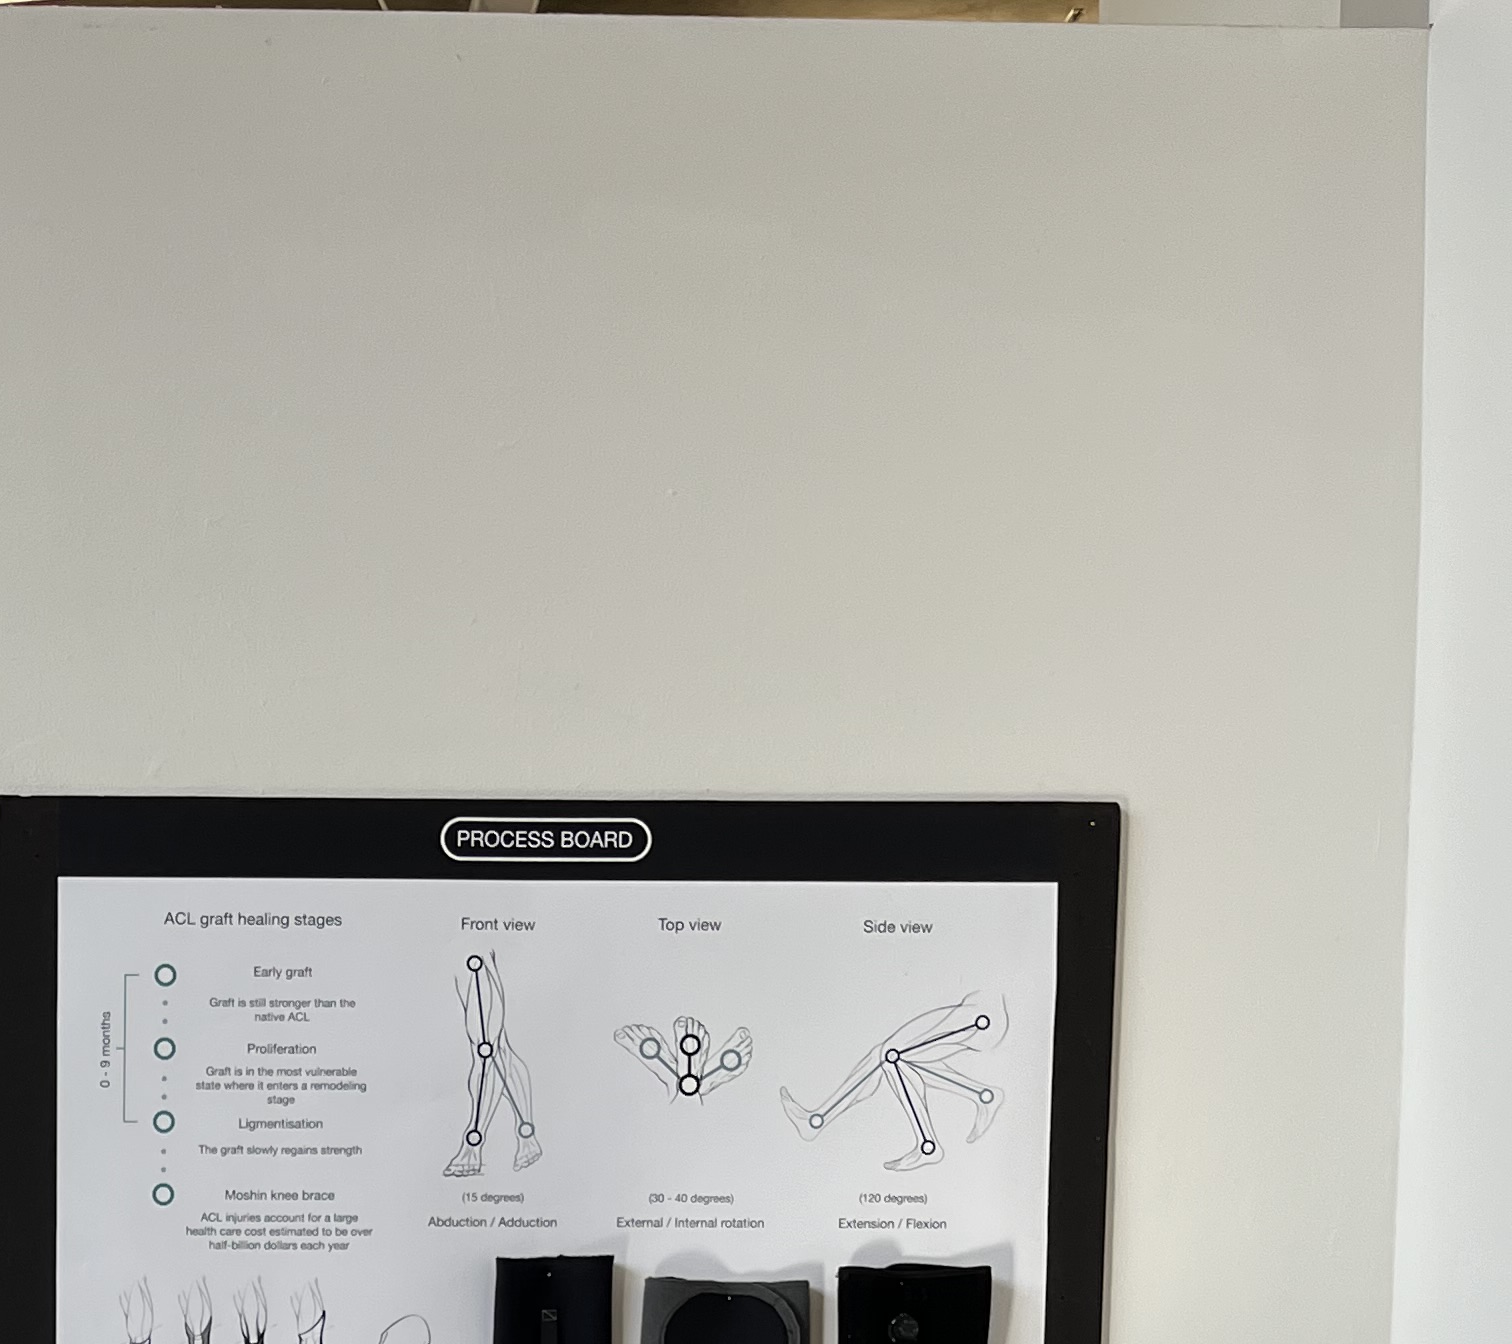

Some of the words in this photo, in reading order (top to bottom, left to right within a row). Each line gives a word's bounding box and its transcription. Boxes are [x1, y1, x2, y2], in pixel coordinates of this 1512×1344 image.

[457, 830, 554, 848] PROCESS
[560, 830, 632, 848] BOARD
[163, 911, 195, 925] ACL
[199, 912, 233, 928] graft
[237, 912, 289, 929] healing
[294, 914, 342, 929] stages
[461, 917, 498, 930] Front
[502, 917, 535, 931] view
[658, 917, 684, 933] Top
[688, 917, 721, 931] view
[863, 919, 896, 933] Side
[899, 920, 933, 933] view
[253, 965, 282, 979] Early
[285, 966, 312, 980] graft
[100, 1011, 111, 1057] months
[247, 1043, 316, 1054] Proliferation
[100, 1060, 111, 1068] 9
[238, 1118, 323, 1131] Ligmentisation
[224, 1189, 267, 1200] Moshin
[270, 1190, 298, 1200] knee
[301, 1189, 335, 1201] brace
